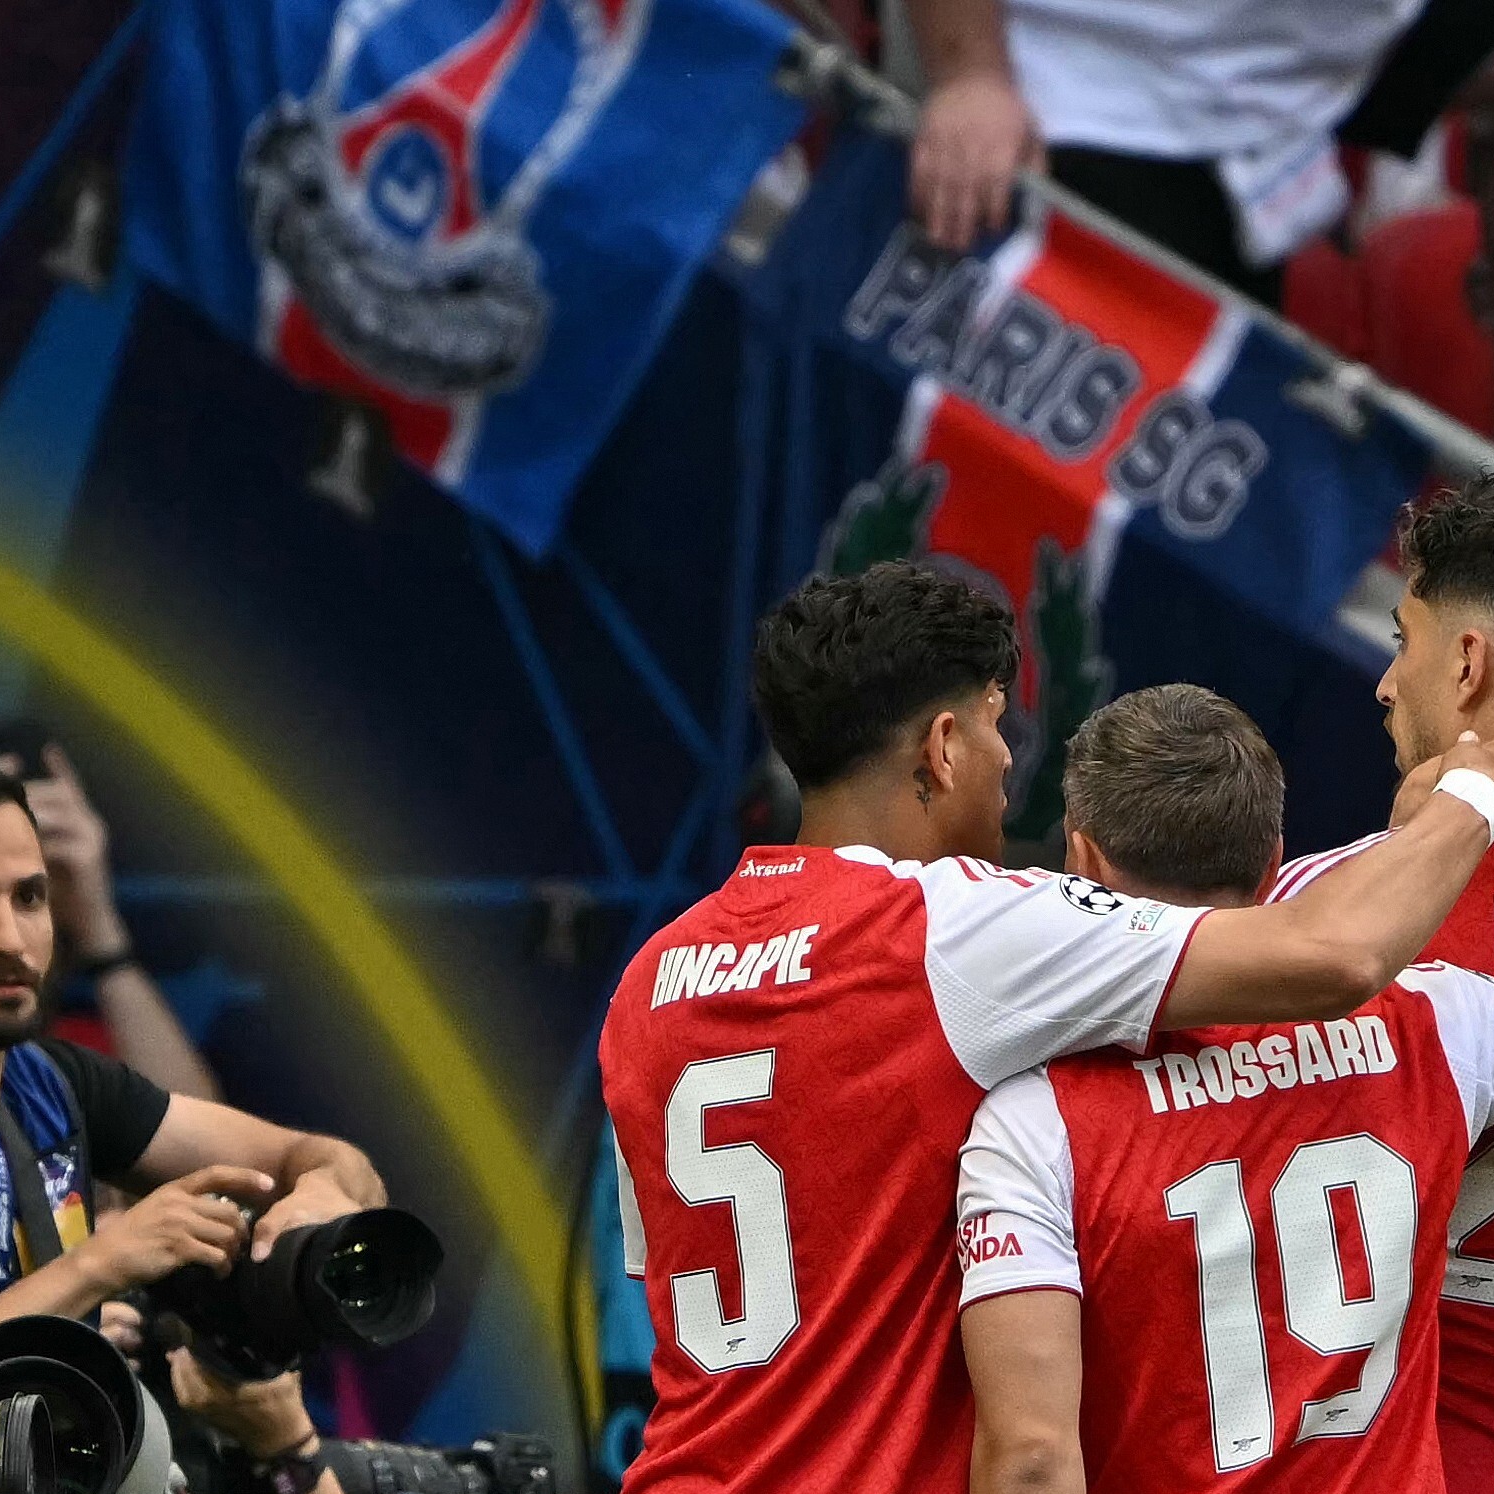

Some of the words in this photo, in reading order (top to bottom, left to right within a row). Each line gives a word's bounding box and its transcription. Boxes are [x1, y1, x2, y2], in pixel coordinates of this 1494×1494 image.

[843, 223, 1144, 462] PARIS
[1110, 387, 1270, 539] SG
[650, 923, 820, 1011] HINCAPIE
[738, 856, 807, 878] Arsenal
[1133, 1015, 1398, 1114] TROSSARD
[665, 1047, 801, 1376] 5
[1163, 1131, 1418, 1473] 19
